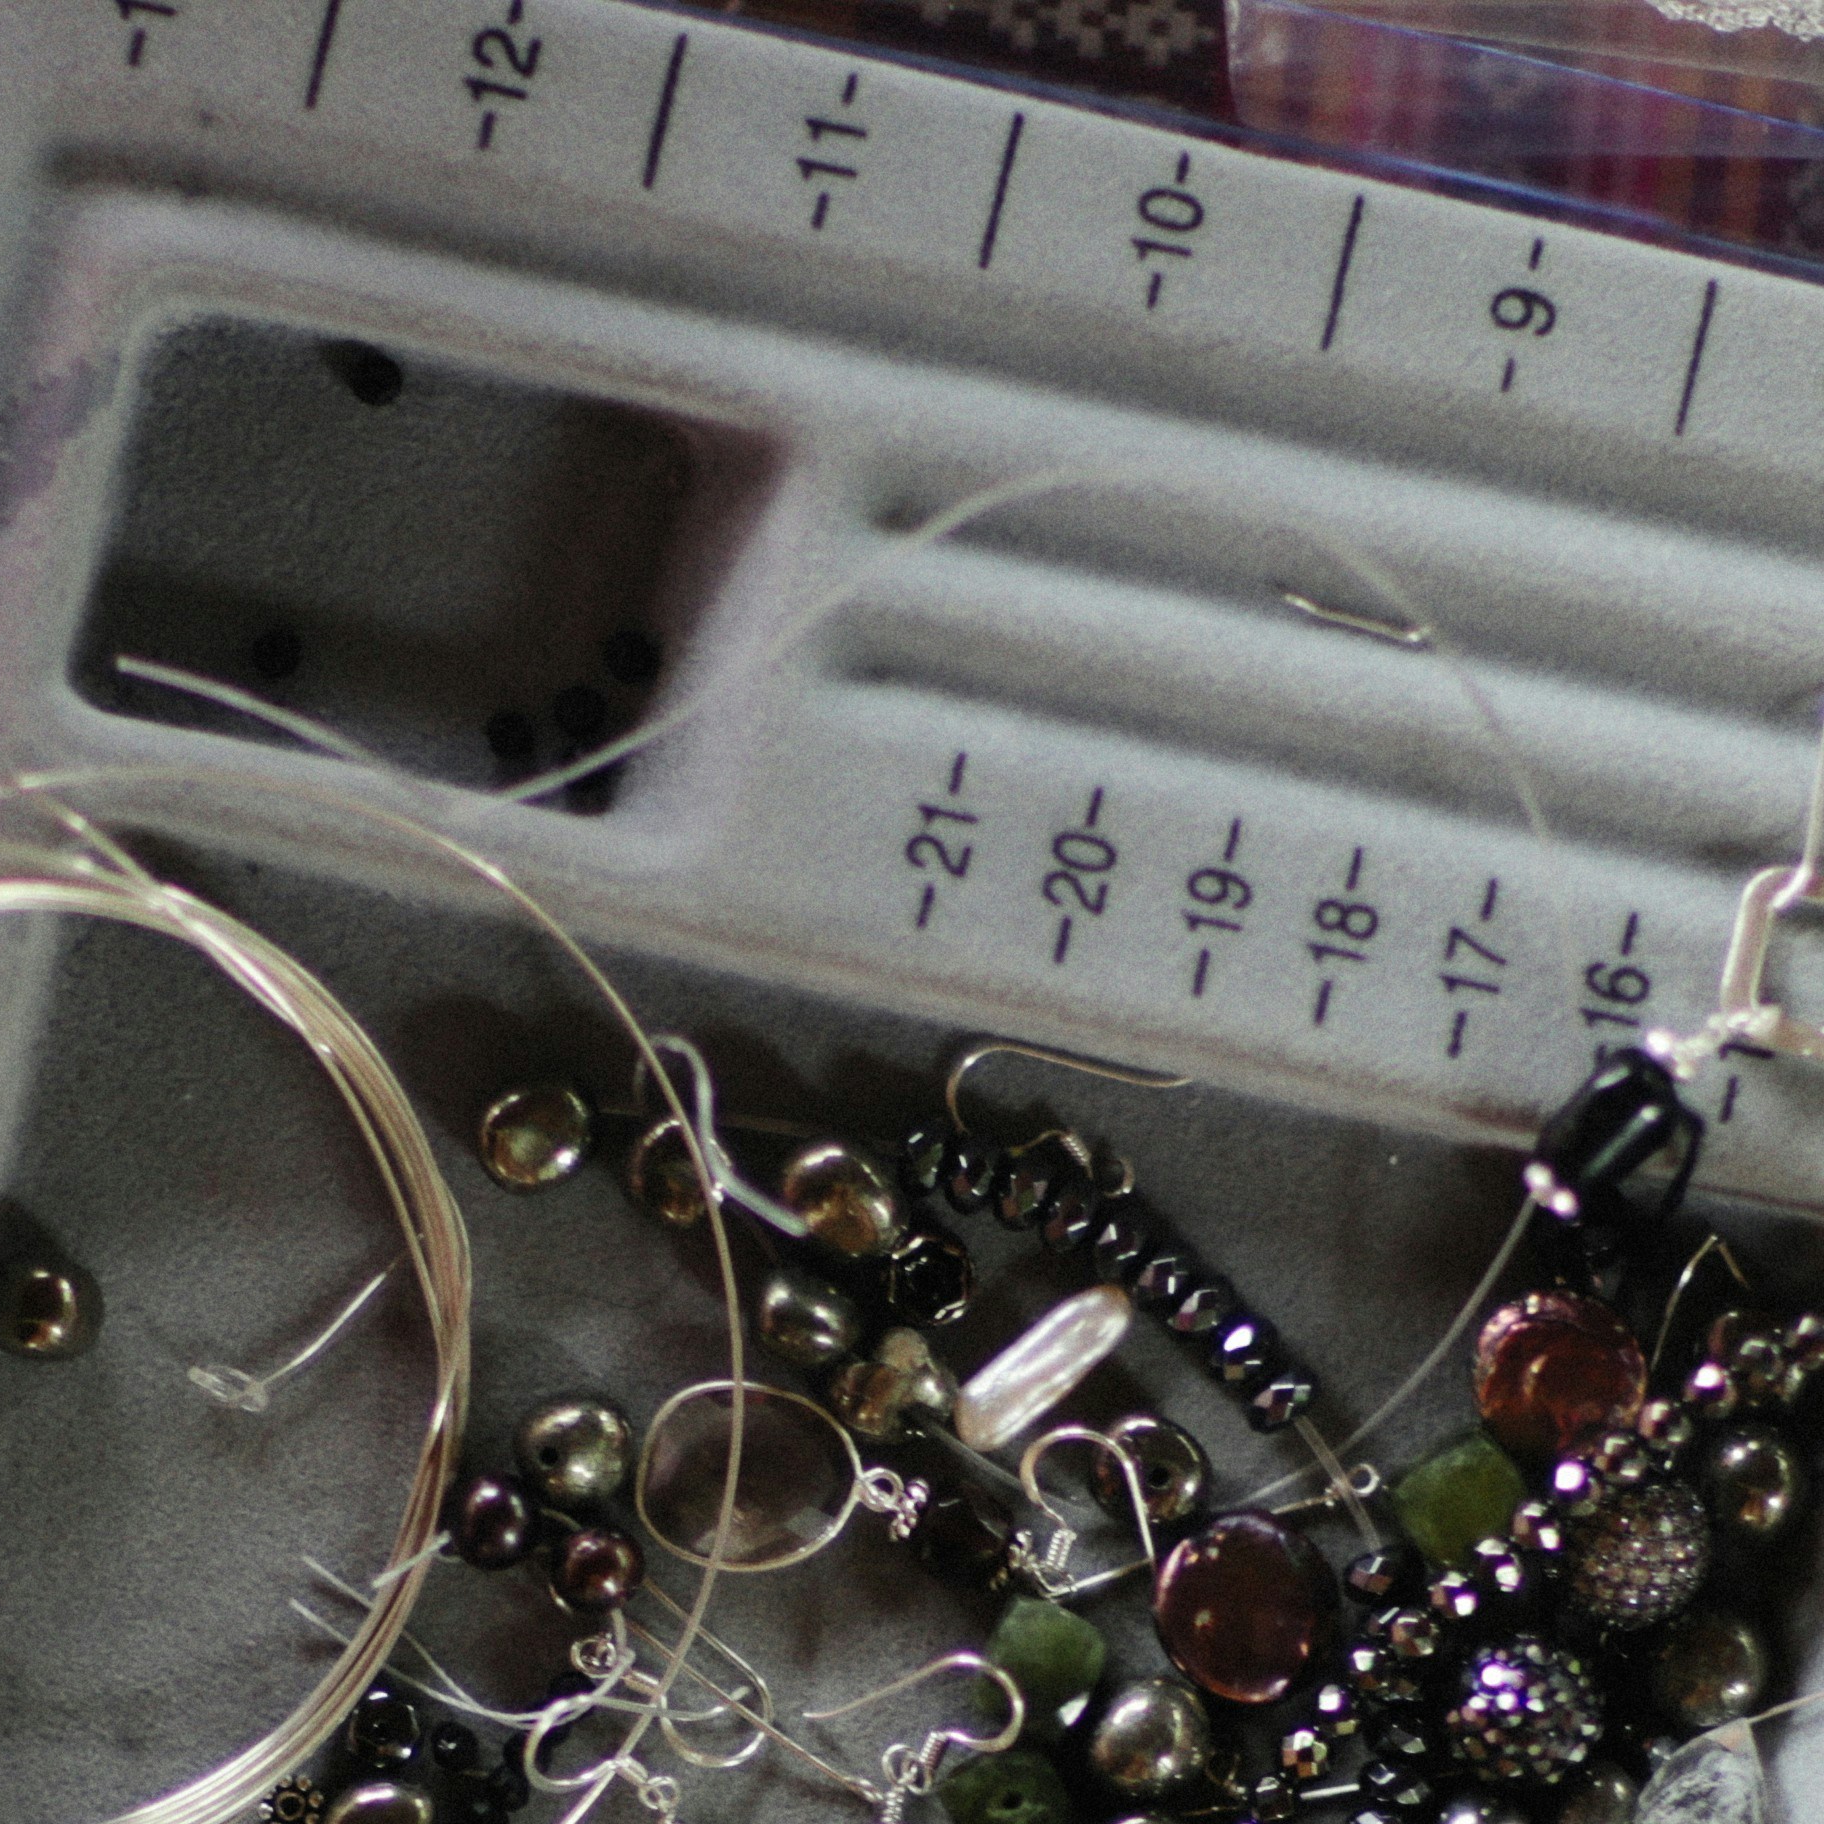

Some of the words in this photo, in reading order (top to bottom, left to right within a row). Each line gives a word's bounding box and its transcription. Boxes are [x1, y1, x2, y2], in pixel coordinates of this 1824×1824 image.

[463, 26, 543, 103] 12
[795, 115, 868, 181] 11
[1131, 186, 1206, 261] 10
[1488, 286, 1558, 338] 9
[903, 802, 979, 880] 21
[1040, 829, 1119, 917] 20
[1183, 865, 1254, 933] 19
[1306, 896, 1381, 963] 18
[1439, 925, 1508, 996] 17
[1579, 960, 1652, 1029] 16
